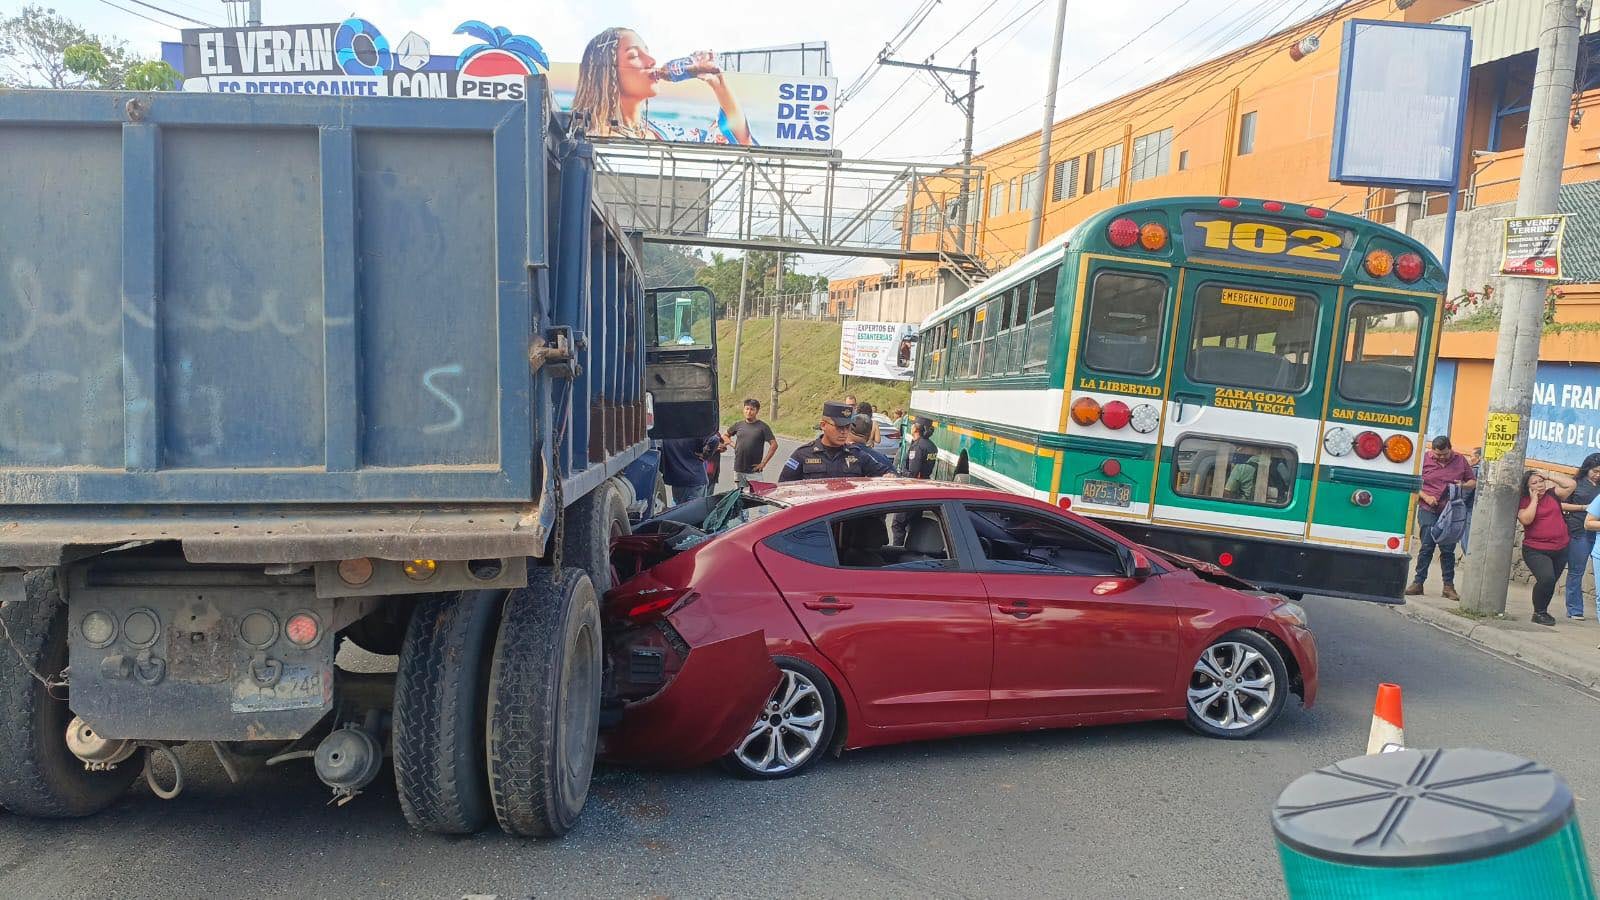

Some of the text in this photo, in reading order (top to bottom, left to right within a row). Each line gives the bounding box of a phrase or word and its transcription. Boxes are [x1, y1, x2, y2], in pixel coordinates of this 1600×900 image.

[199, 32, 232, 74] EL
[393, 72, 448, 98] CON
[462, 79, 524, 99] PEPS
[779, 83, 828, 101] SED
[777, 103, 810, 120] DE
[776, 121, 831, 142] MÁS
[1509, 218, 1559, 228] SE VENDE
[1512, 225, 1556, 234] TERRENO
[1194, 219, 1342, 262] 102
[1222, 290, 1294, 308] EMERGENCY DOOR
[857, 324, 896, 333] EXPERTOS EN
[1080, 377, 1162, 396] LA LIBERTAD
[1532, 382, 1556, 406] NA
[1215, 387, 1296, 406] ZARAGOZA
[1214, 398, 1295, 416] SANTA TECLA
[1332, 409, 1413, 426] SAN SALVADOR
[1494, 424, 1508, 432] SE
[1529, 419, 1564, 443] UILER
[1567, 423, 1585, 446] DE
